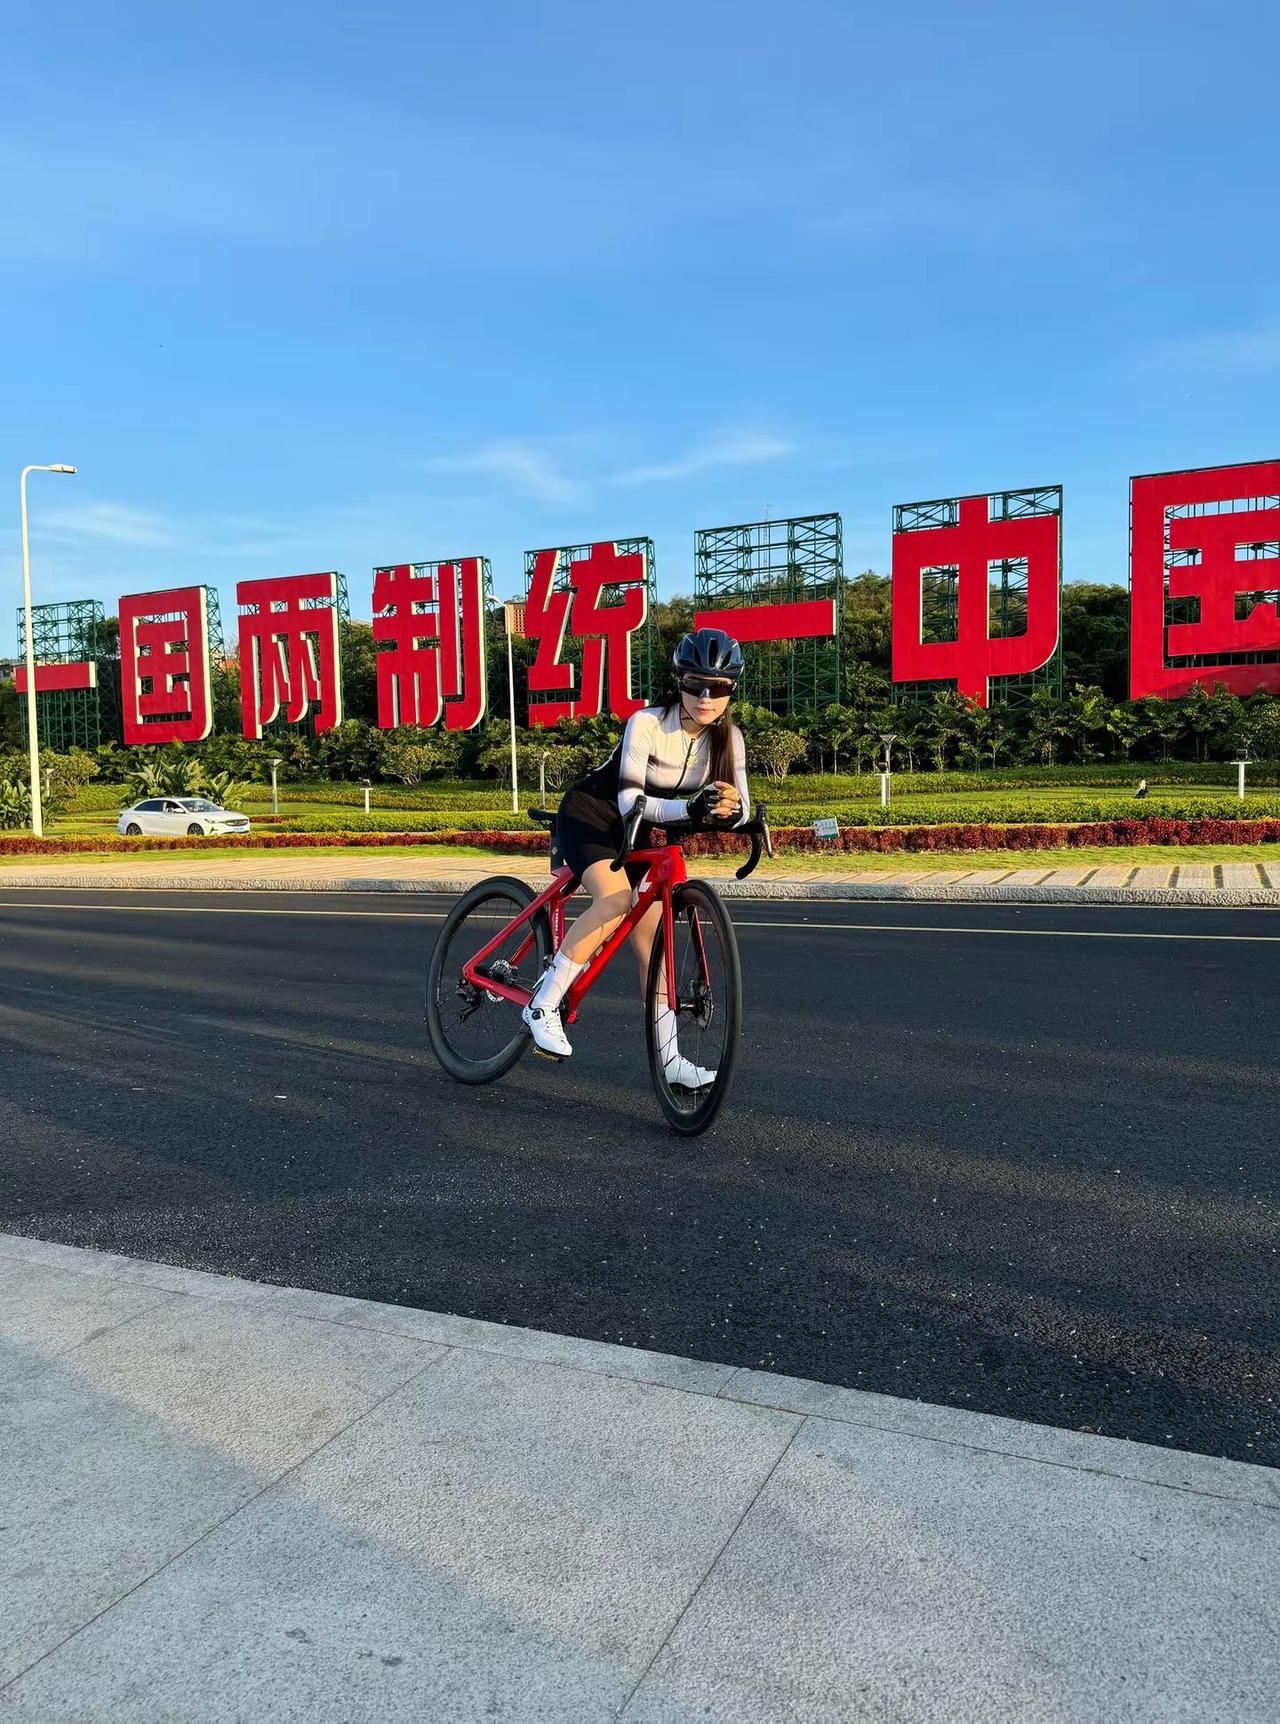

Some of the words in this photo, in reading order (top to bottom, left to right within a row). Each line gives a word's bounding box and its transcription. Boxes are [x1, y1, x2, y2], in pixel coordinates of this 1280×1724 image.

[15, 463, 1280, 744] 一国两制统一中国
